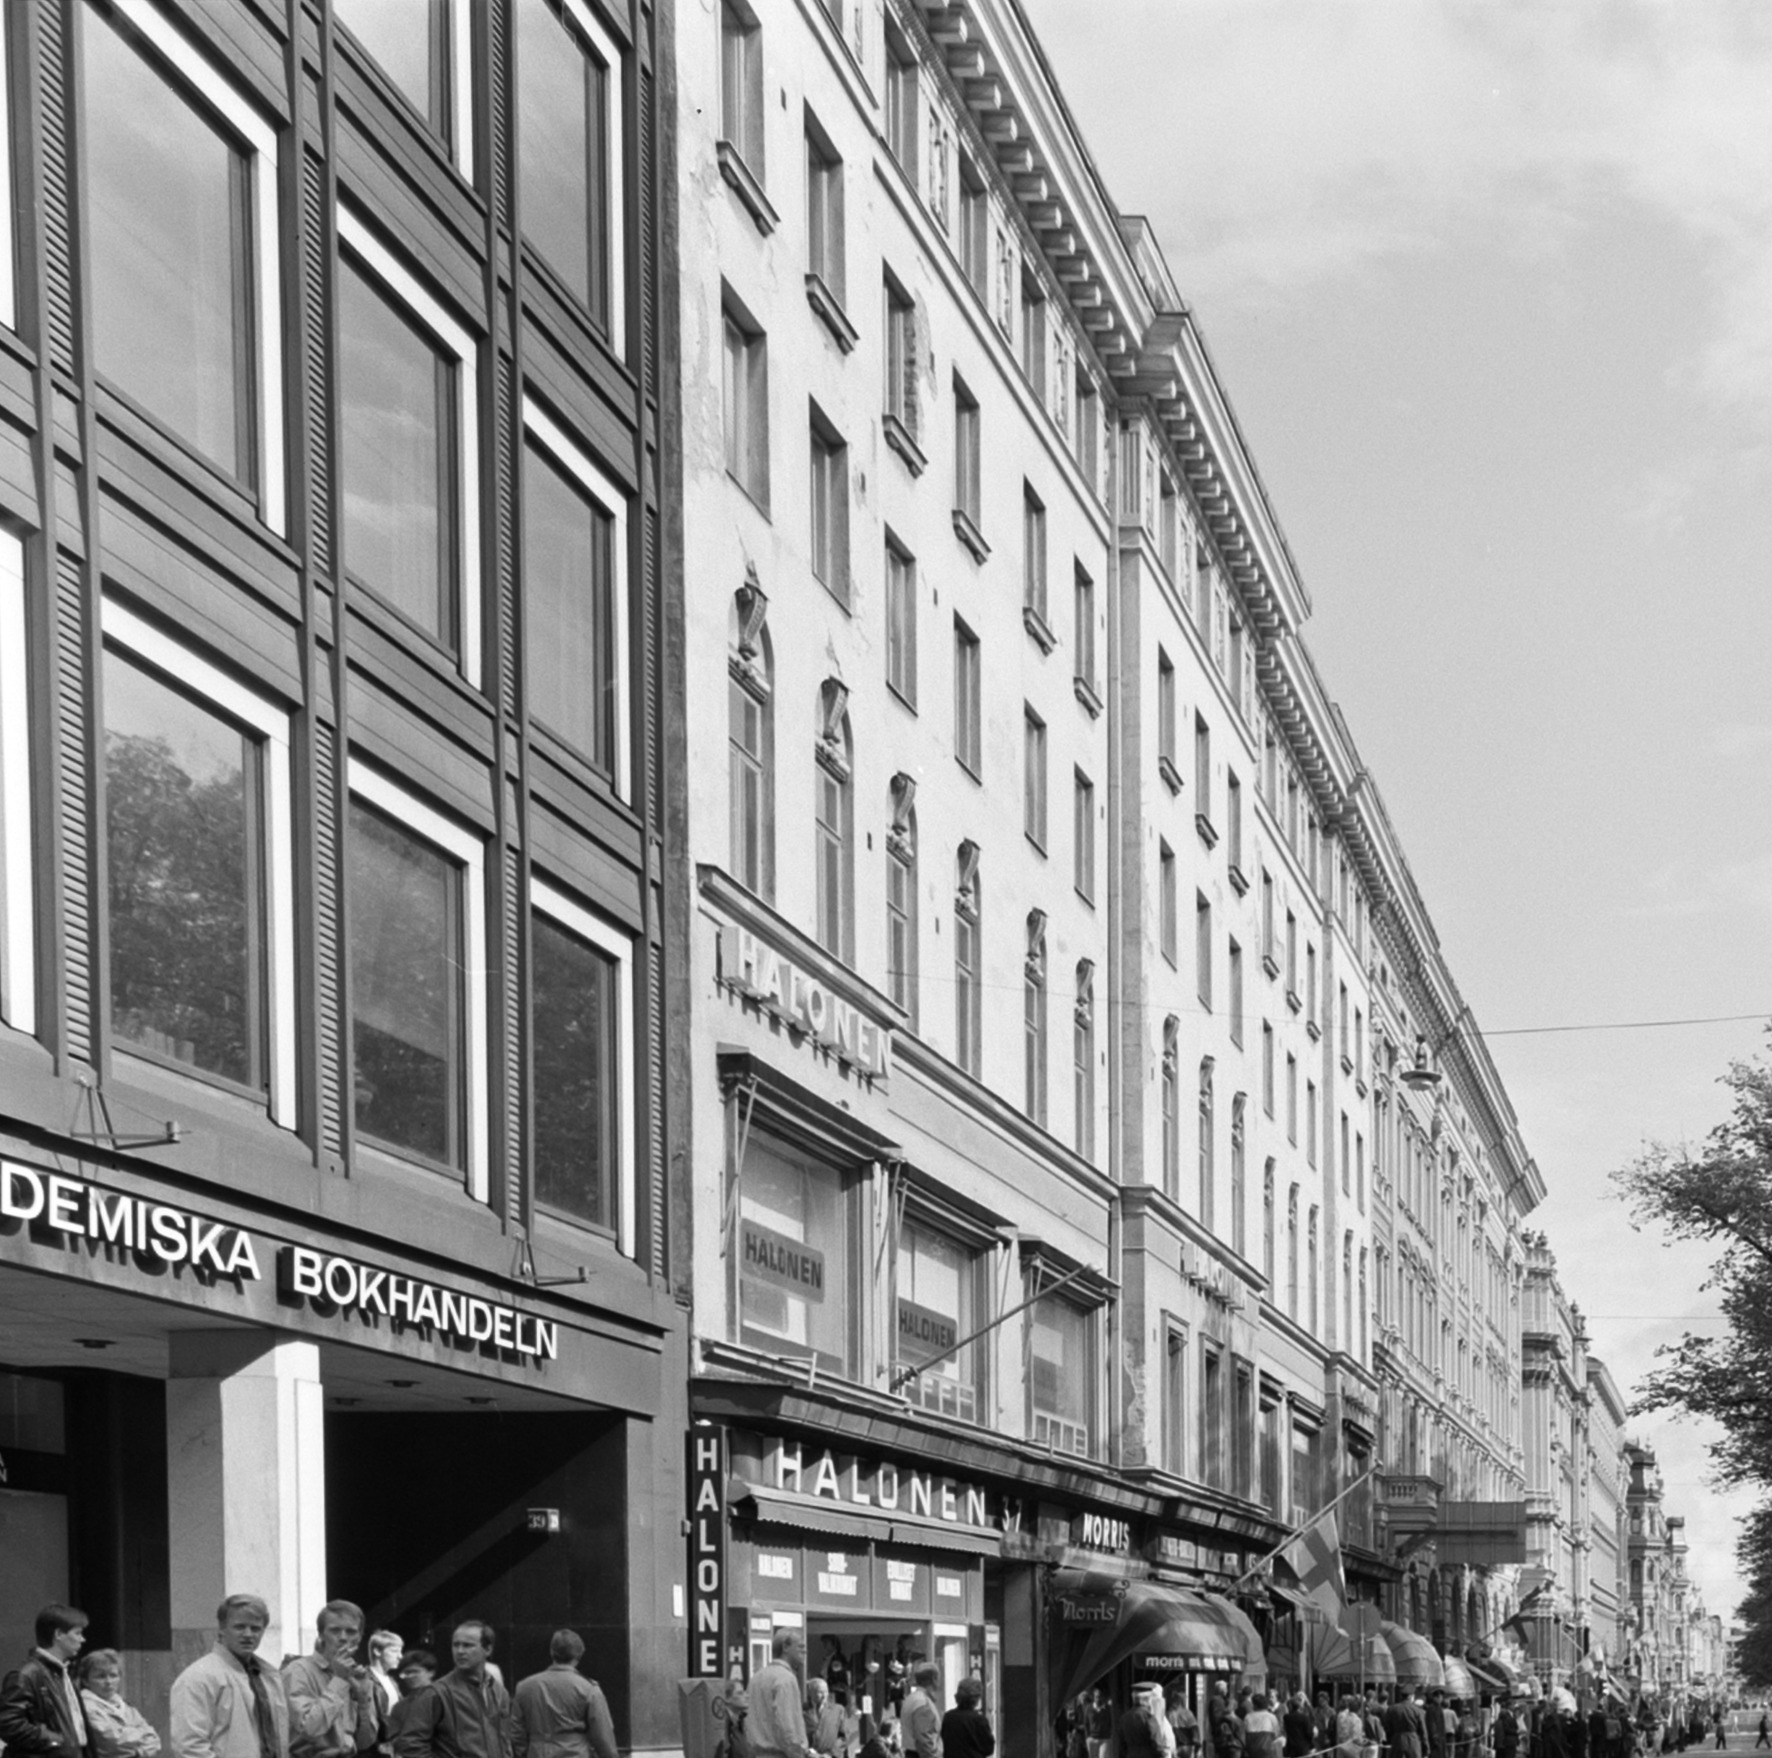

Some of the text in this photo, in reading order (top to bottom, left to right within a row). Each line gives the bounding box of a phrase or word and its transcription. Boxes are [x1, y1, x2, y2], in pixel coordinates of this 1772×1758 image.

[735, 926, 892, 1080] HALONEN
[745, 1232, 822, 1289] HALONEN
[293, 1246, 557, 1359] BOKHANDELN
[899, 1308, 955, 1350] HALONEN
[777, 1438, 985, 1526] HALONEN
[528, 1513, 546, 1529] 39
[696, 1438, 719, 1673] HALONE
[1083, 1513, 1129, 1551] MORRIS
